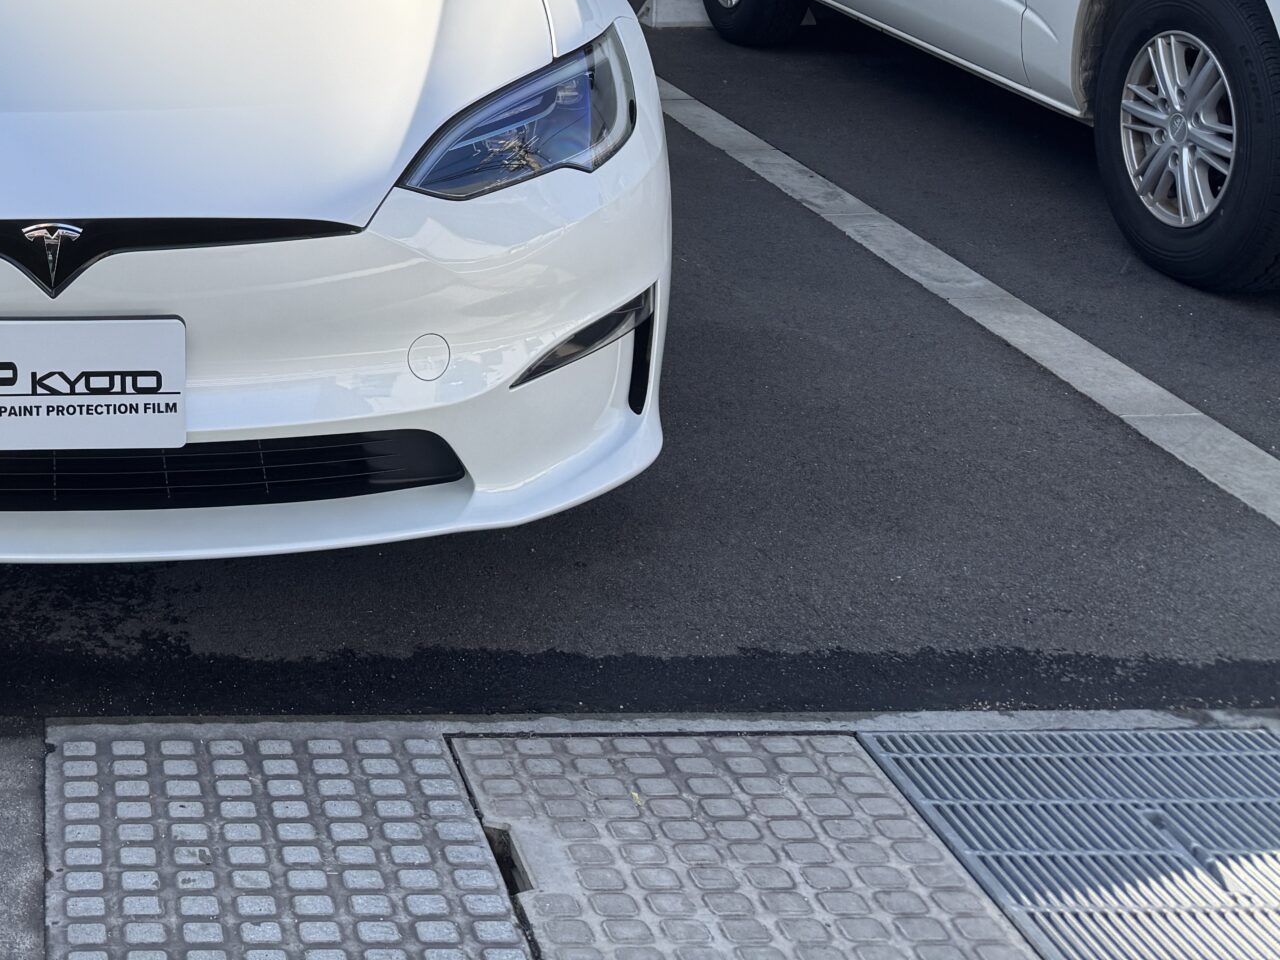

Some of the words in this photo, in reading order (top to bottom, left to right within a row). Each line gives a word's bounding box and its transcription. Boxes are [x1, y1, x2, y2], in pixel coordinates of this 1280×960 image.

[31, 370, 162, 395] KYOTO
[46, 403, 140, 417] PROTECTION
[143, 402, 178, 415] FILM
